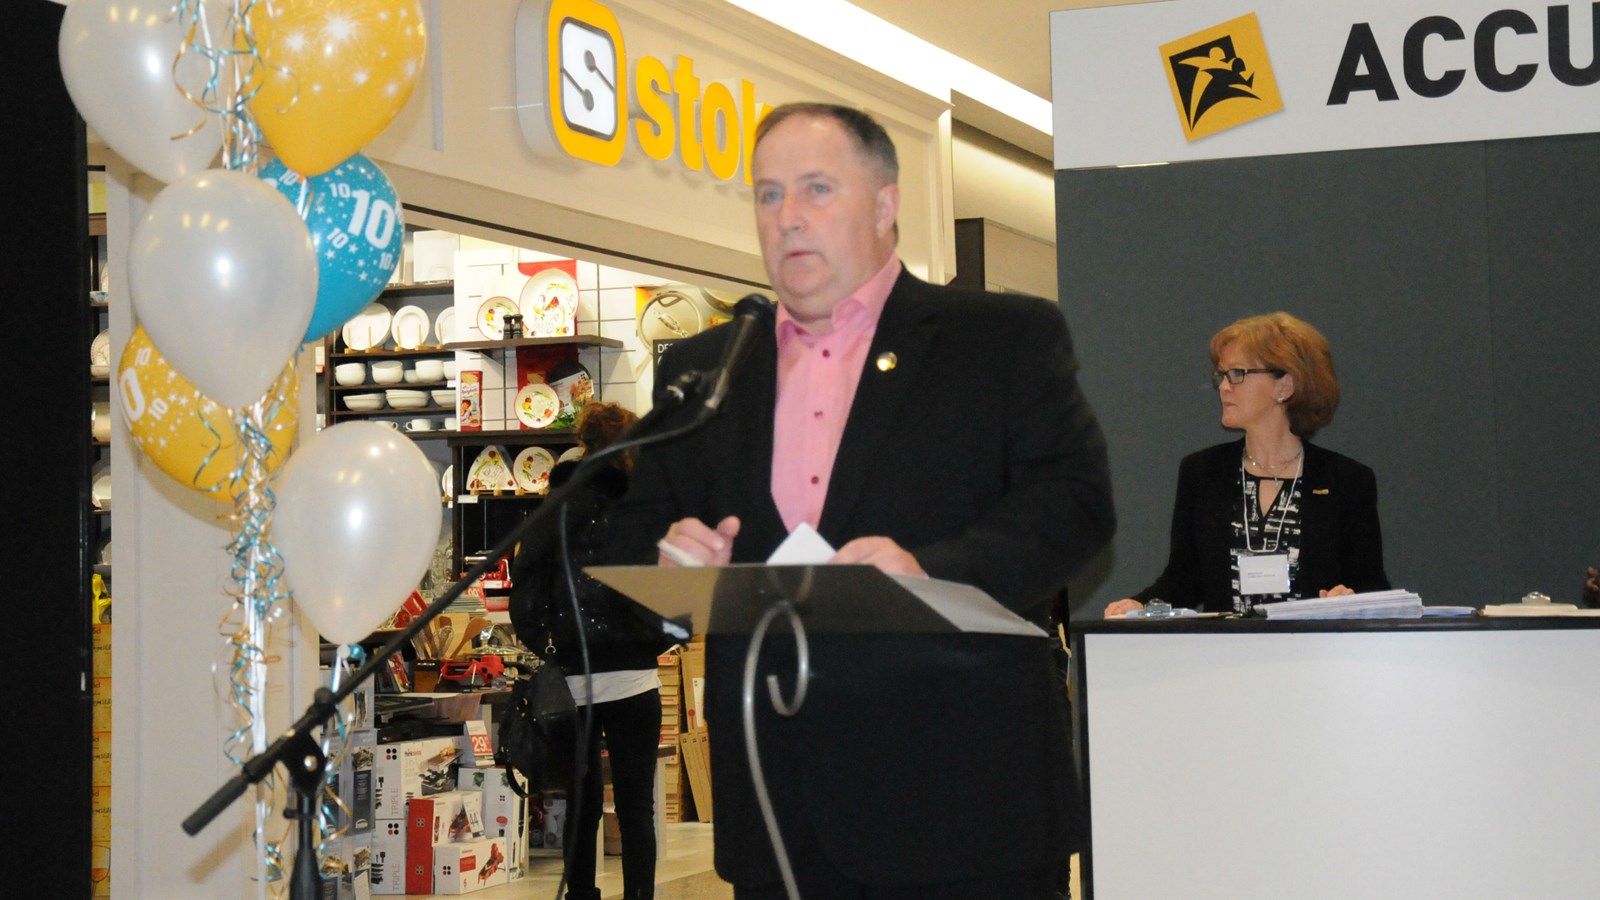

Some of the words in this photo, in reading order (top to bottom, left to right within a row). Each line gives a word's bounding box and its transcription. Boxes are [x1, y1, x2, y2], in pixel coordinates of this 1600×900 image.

[1326, 1, 1600, 106] ACCU
[329, 182, 351, 198] 10
[347, 189, 395, 250] 10
[327, 227, 350, 249] 10
[379, 252, 393, 270] 10
[134, 347, 152, 366] 10
[657, 343, 673, 353] DE
[148, 397, 169, 420] 10
